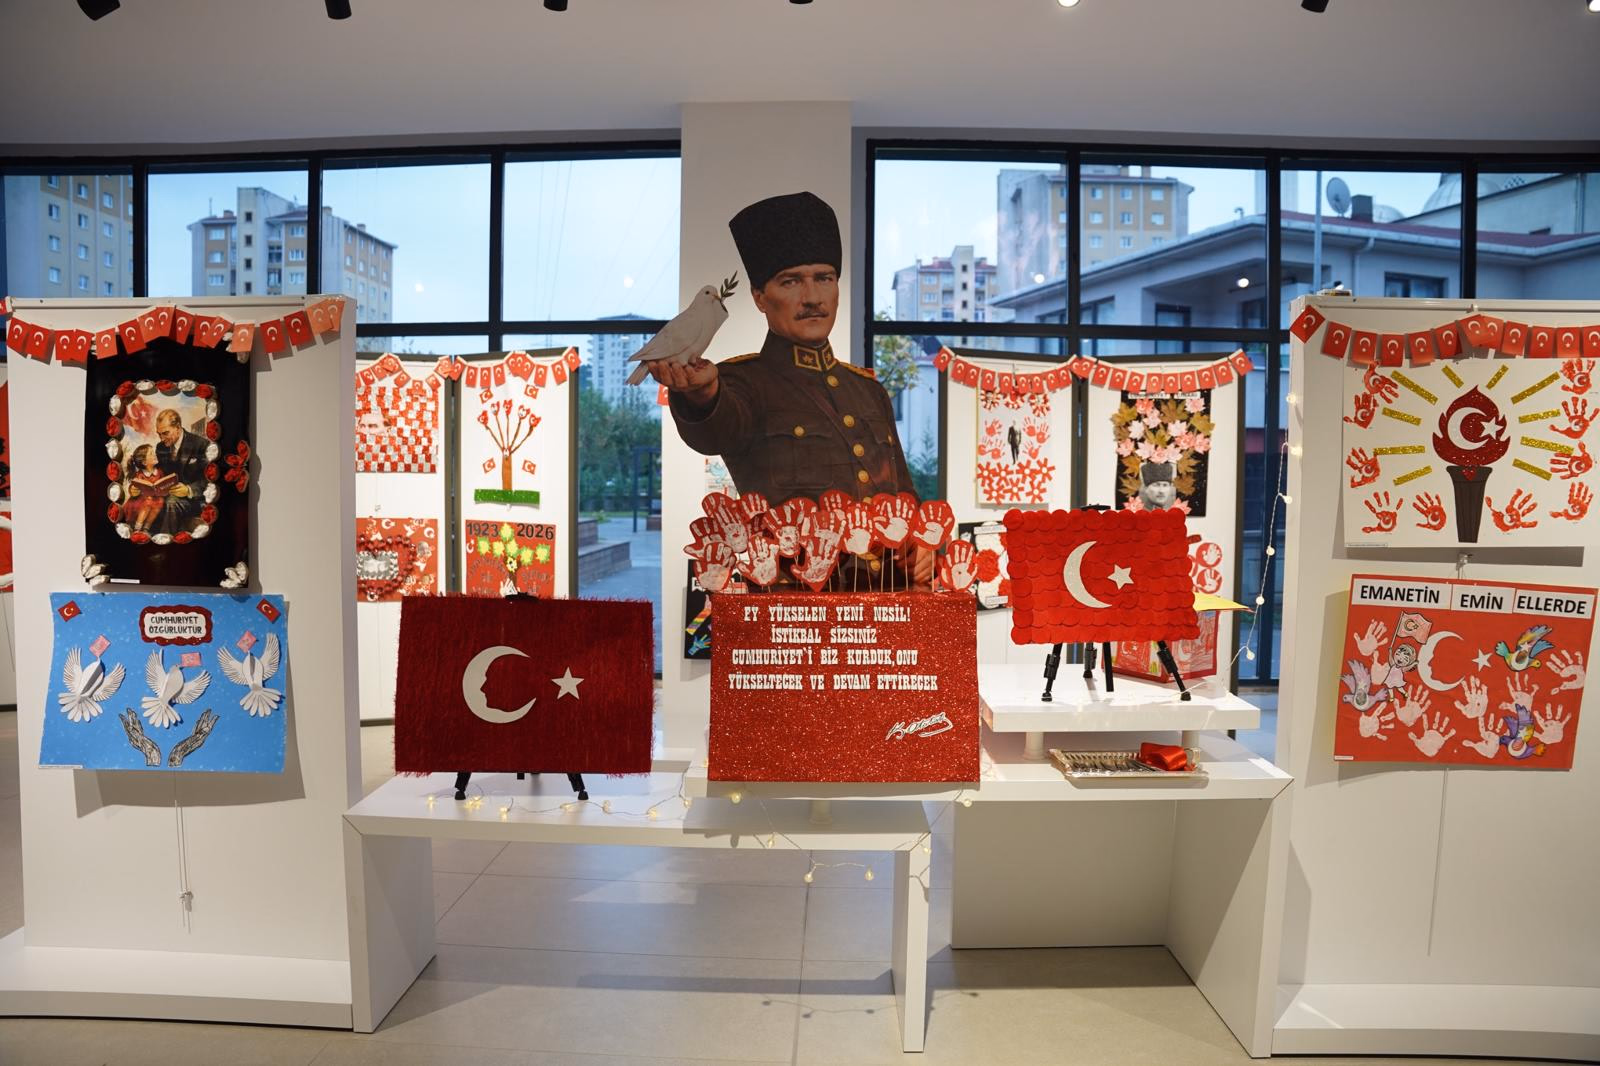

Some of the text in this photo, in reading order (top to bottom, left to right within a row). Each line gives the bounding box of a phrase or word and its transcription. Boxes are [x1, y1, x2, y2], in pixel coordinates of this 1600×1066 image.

[467, 523, 553, 540] 1923 2026
[1360, 585, 1587, 614] EMANETİN EMİN ELLERDE
[769, 604, 826, 621] YÜKSELEN
[836, 603, 864, 621] YENİ
[874, 604, 910, 621] NESİL!
[771, 625, 821, 644] İSTİKBAL
[821, 646, 838, 665] BİZ
[728, 672, 937, 691] YÜKSELTECEK VE DEVAM ETTİRECEK
